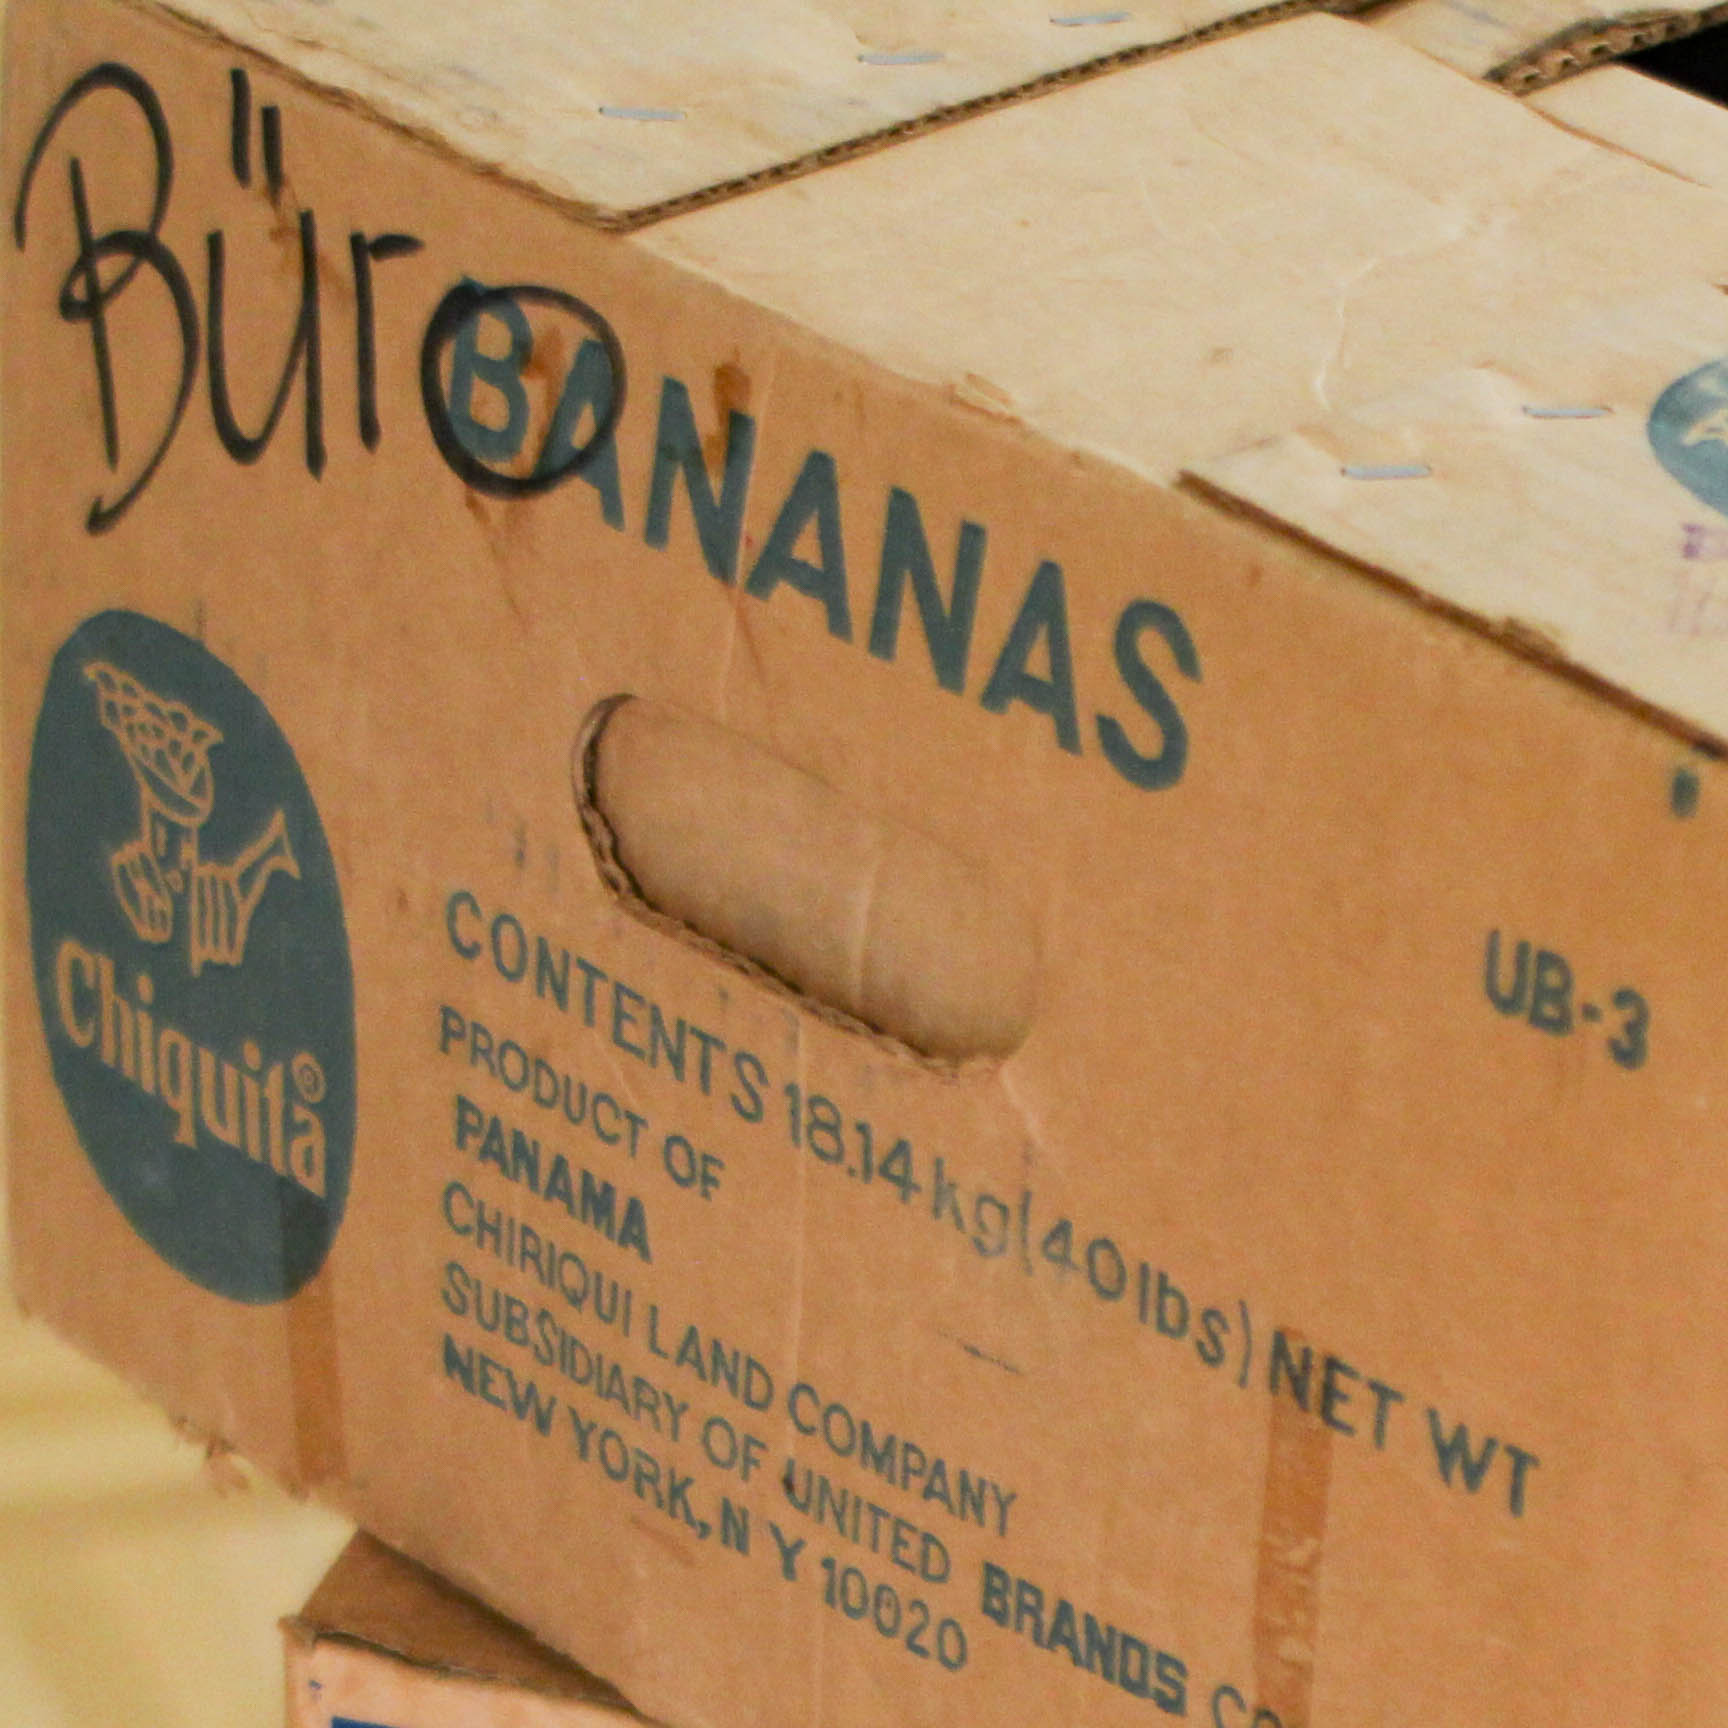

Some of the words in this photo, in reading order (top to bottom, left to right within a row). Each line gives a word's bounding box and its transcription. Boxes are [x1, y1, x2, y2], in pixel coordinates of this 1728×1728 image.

[15, 60, 628, 534] Büro
[446, 275, 1202, 791] BANANAS
[55, 938, 327, 1199] Chiquita
[438, 1004, 648, 1158] PRODUCT
[663, 1134, 724, 1201] OF
[1484, 928, 1651, 1071] UB-3
[445, 890, 769, 1124] CONTENTS
[784, 1082, 922, 1205] 18.14
[1269, 1325, 1405, 1450] NET
[1426, 1407, 1540, 1518] WT
[454, 1094, 652, 1263] PANAMA
[441, 1261, 689, 1443] SUBSIDIARY
[702, 1417, 767, 1482] OF
[782, 1459, 951, 1583] UNITED
[980, 1561, 1189, 1717] BRANDS
[442, 1180, 632, 1337] CHIRIQUI
[649, 1306, 771, 1413] LAND
[786, 1383, 1017, 1537] COMPANY
[442, 1333, 556, 1437] NEW
[569, 1406, 712, 1539] YORK,
[821, 1556, 968, 1672] 10020
